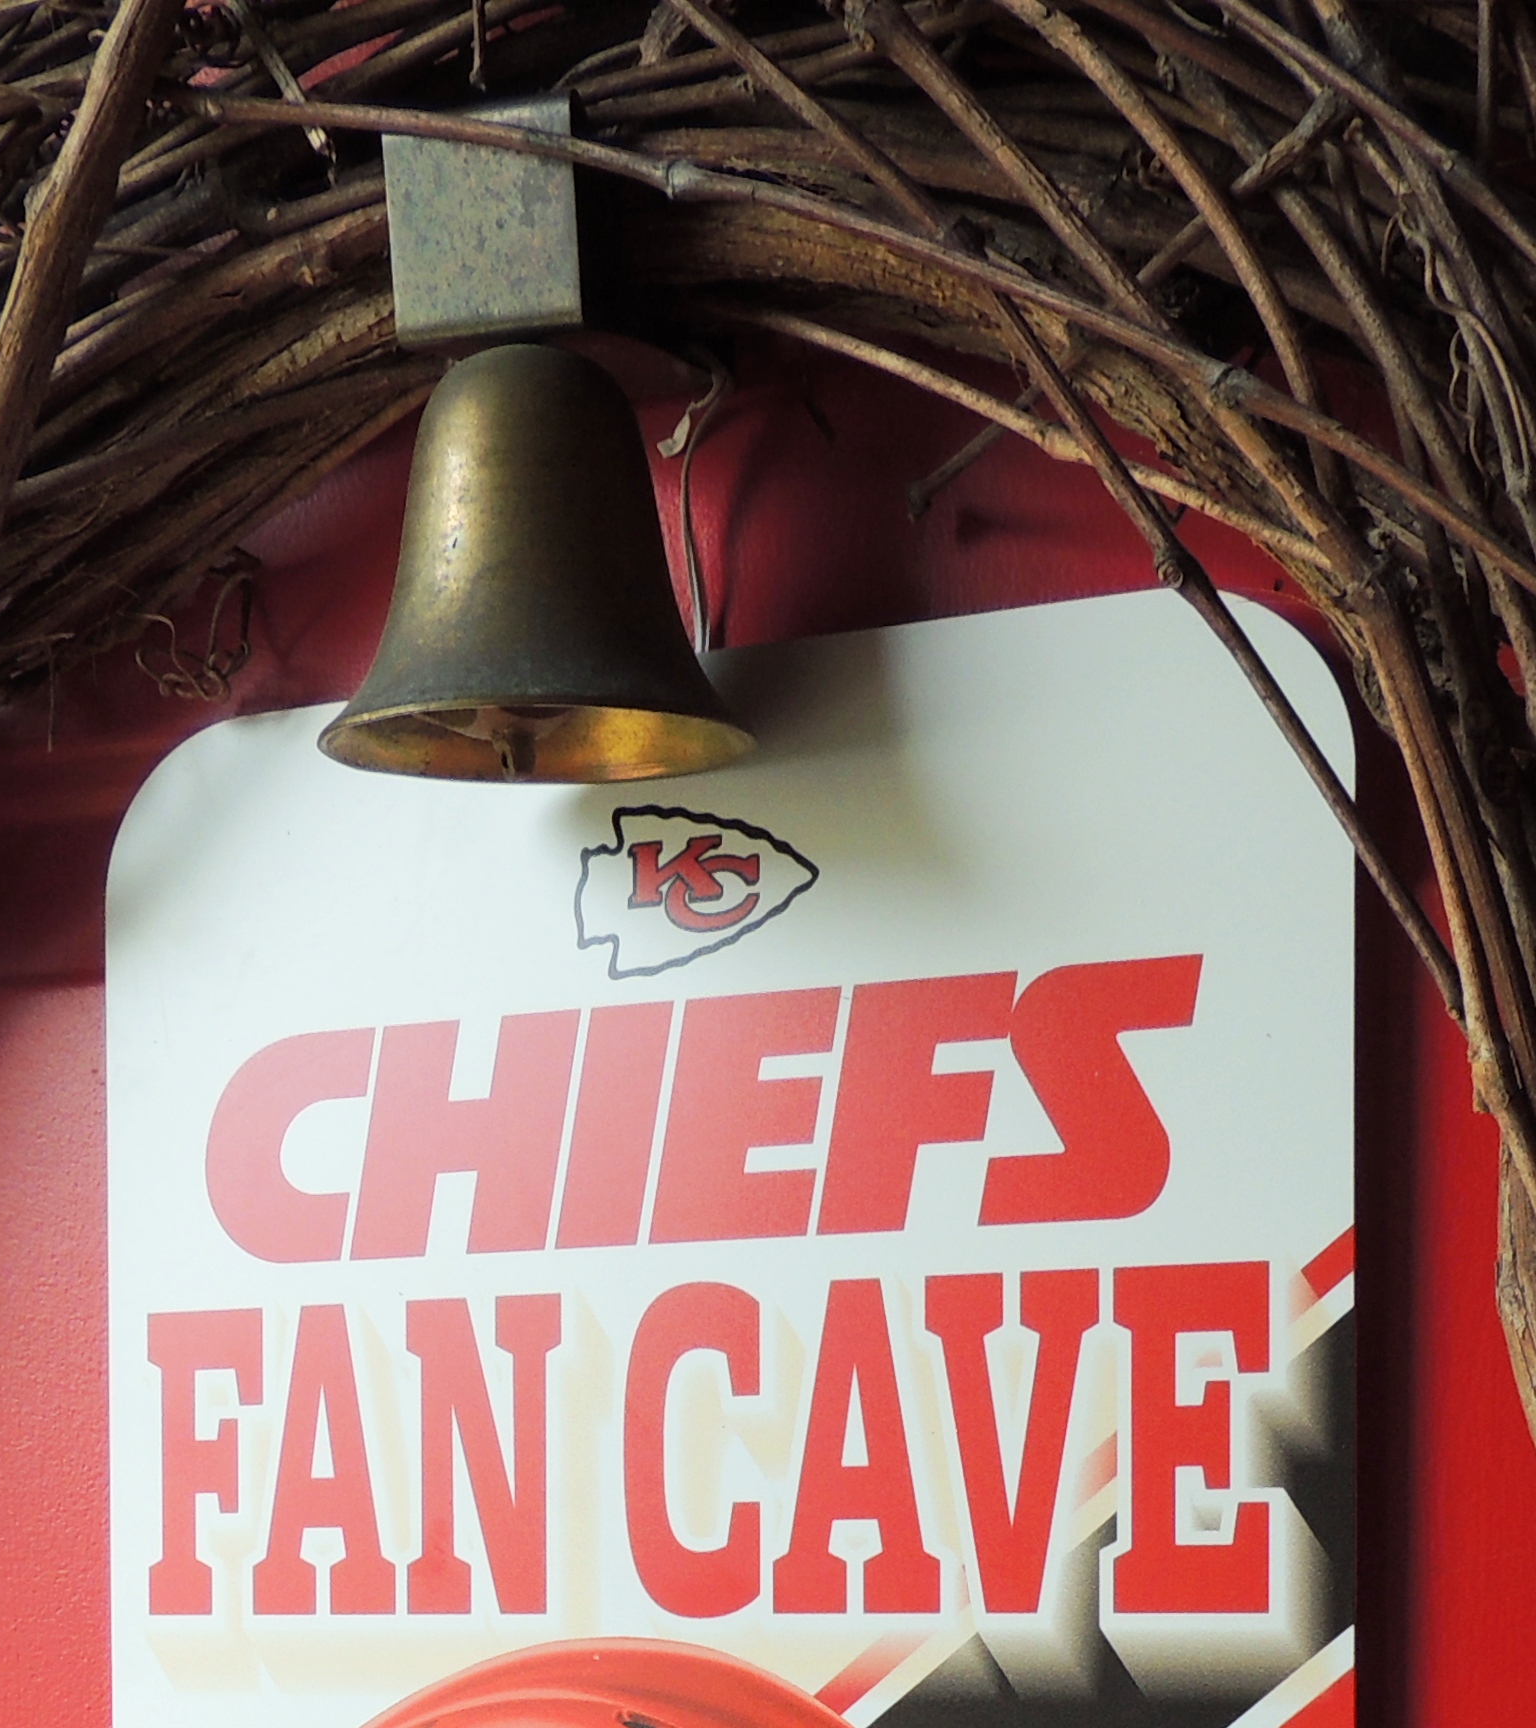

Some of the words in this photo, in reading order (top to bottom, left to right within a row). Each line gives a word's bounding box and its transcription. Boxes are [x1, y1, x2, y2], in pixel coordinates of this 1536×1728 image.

[628, 834, 760, 933] KC
[204, 953, 1203, 1264] CHIEFS
[146, 1293, 562, 1617] FAN
[623, 1260, 1270, 1620] CAVE
